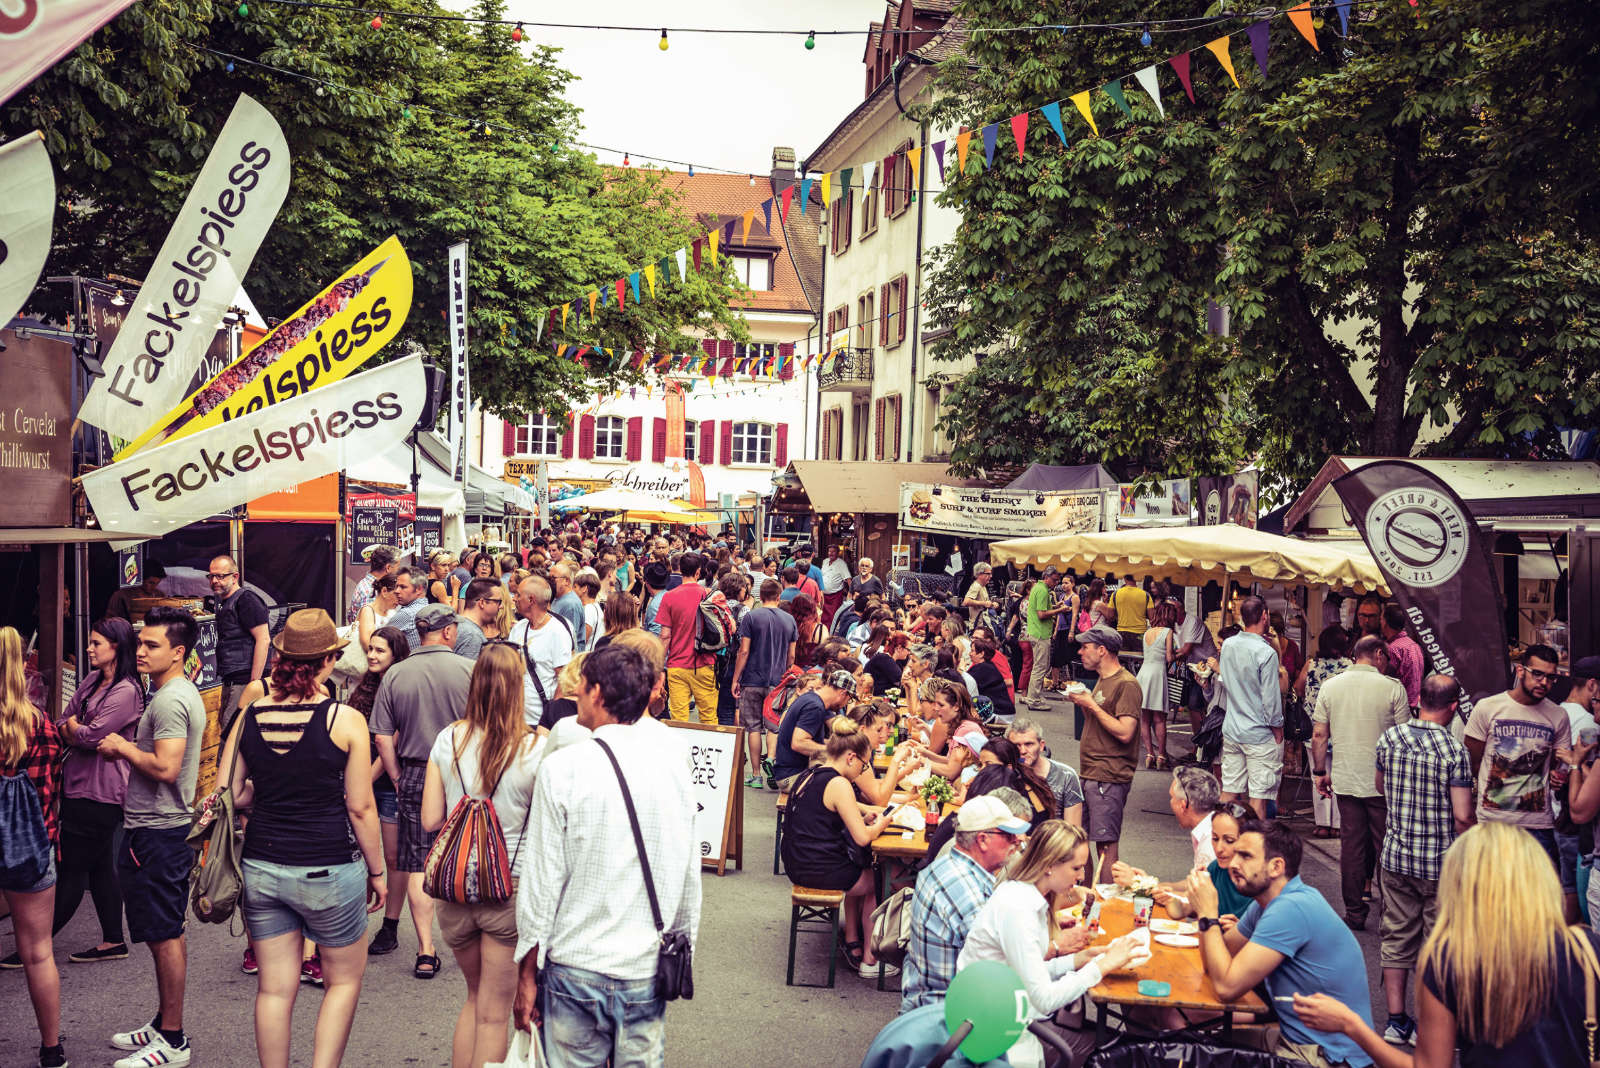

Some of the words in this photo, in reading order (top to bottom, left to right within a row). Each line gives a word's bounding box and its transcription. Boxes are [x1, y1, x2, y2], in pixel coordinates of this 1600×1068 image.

[108, 141, 271, 407] Fackelspiess
[14, 407, 57, 437] Cervelat
[0, 441, 51, 470] hilliwurst
[120, 392, 402, 511] Fackelspiess
[940, 503, 965, 512] SURF
[974, 506, 1002, 515] TURF
[1003, 508, 1047, 518] SMOKER
[960, 495, 979, 503] THE
[981, 496, 1022, 506] HISKY
[356, 513, 374, 525] Gua
[375, 512, 394, 527] Bao
[1495, 725, 1551, 742] NORTHWEST
[691, 745, 722, 765] RMET
